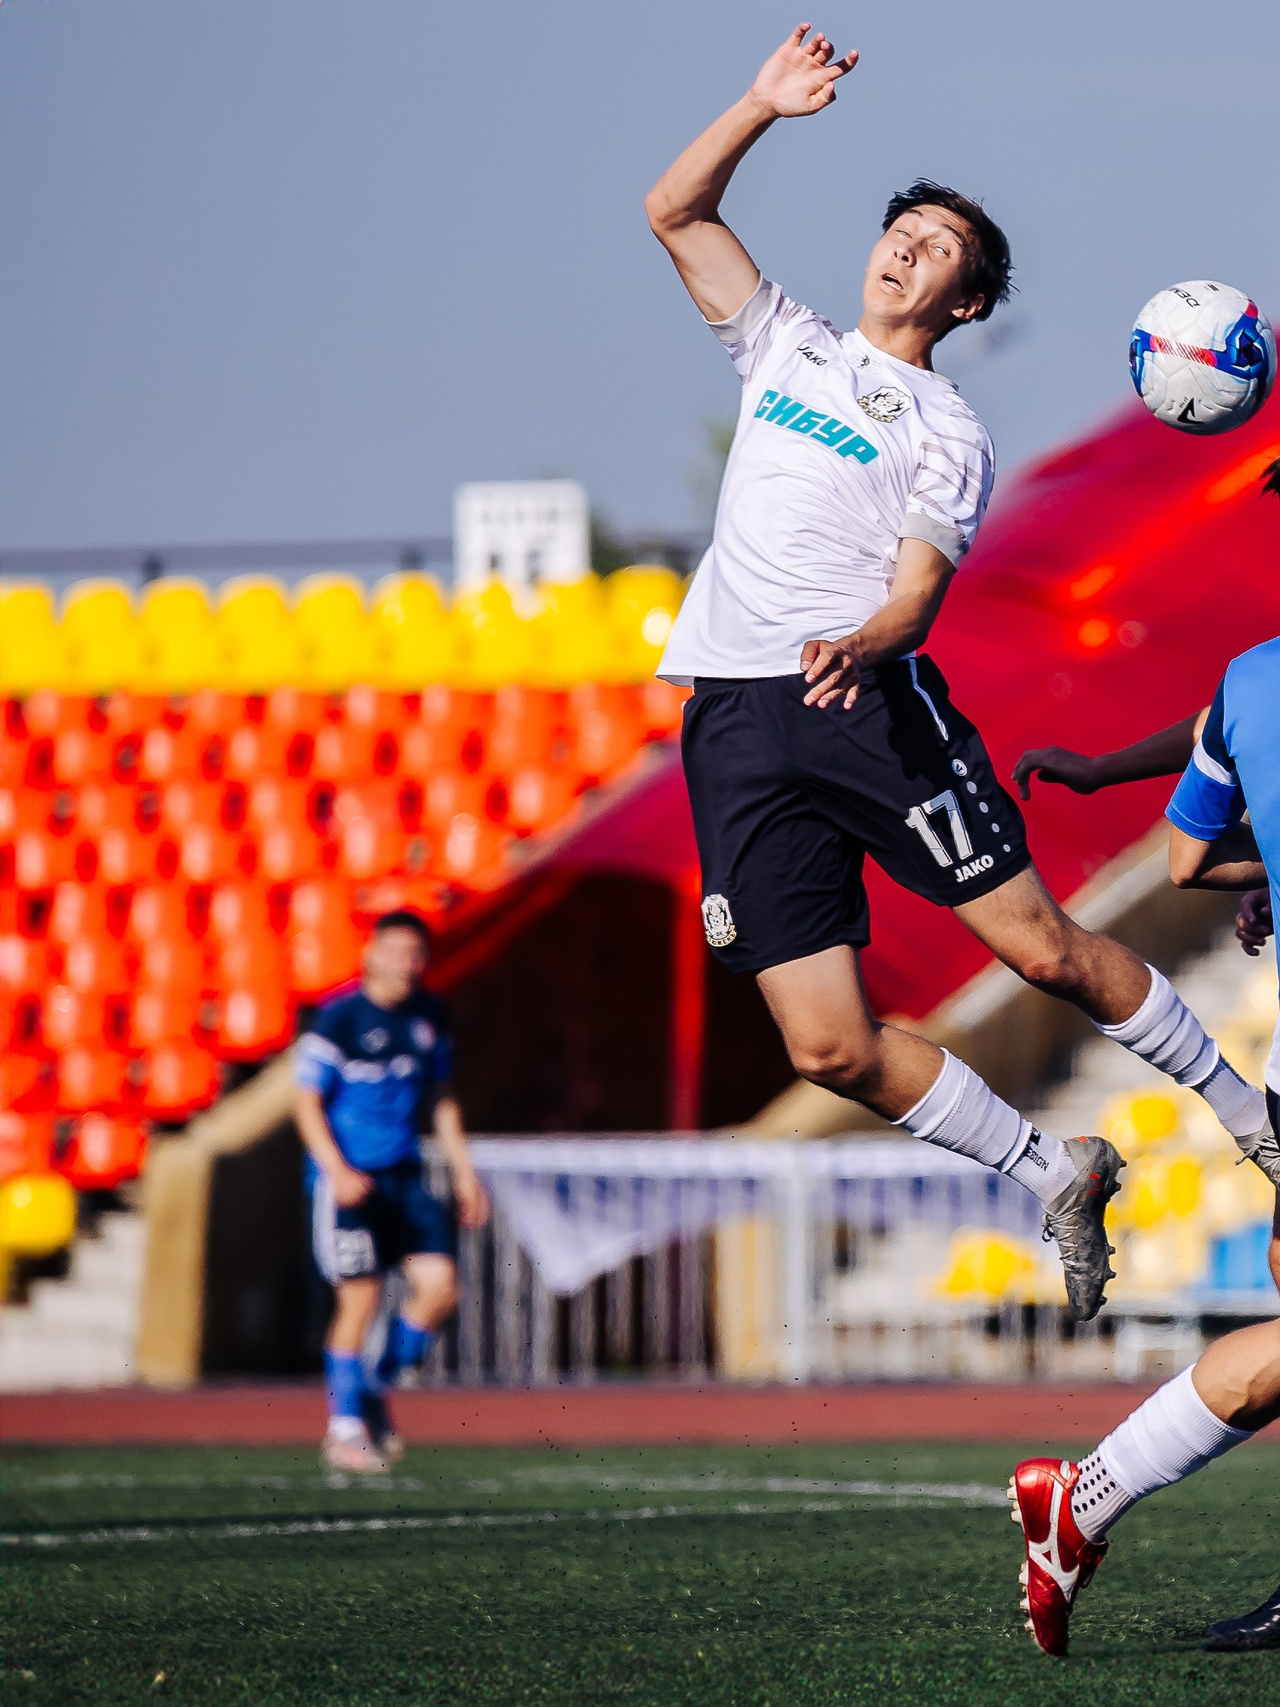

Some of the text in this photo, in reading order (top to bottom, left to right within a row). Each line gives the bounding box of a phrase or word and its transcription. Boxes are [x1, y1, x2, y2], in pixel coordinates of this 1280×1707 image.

[797, 346, 828, 366] JAKO
[754, 389, 880, 465] СИБУР
[904, 789, 974, 867] 17
[954, 854, 994, 883] JAKO
